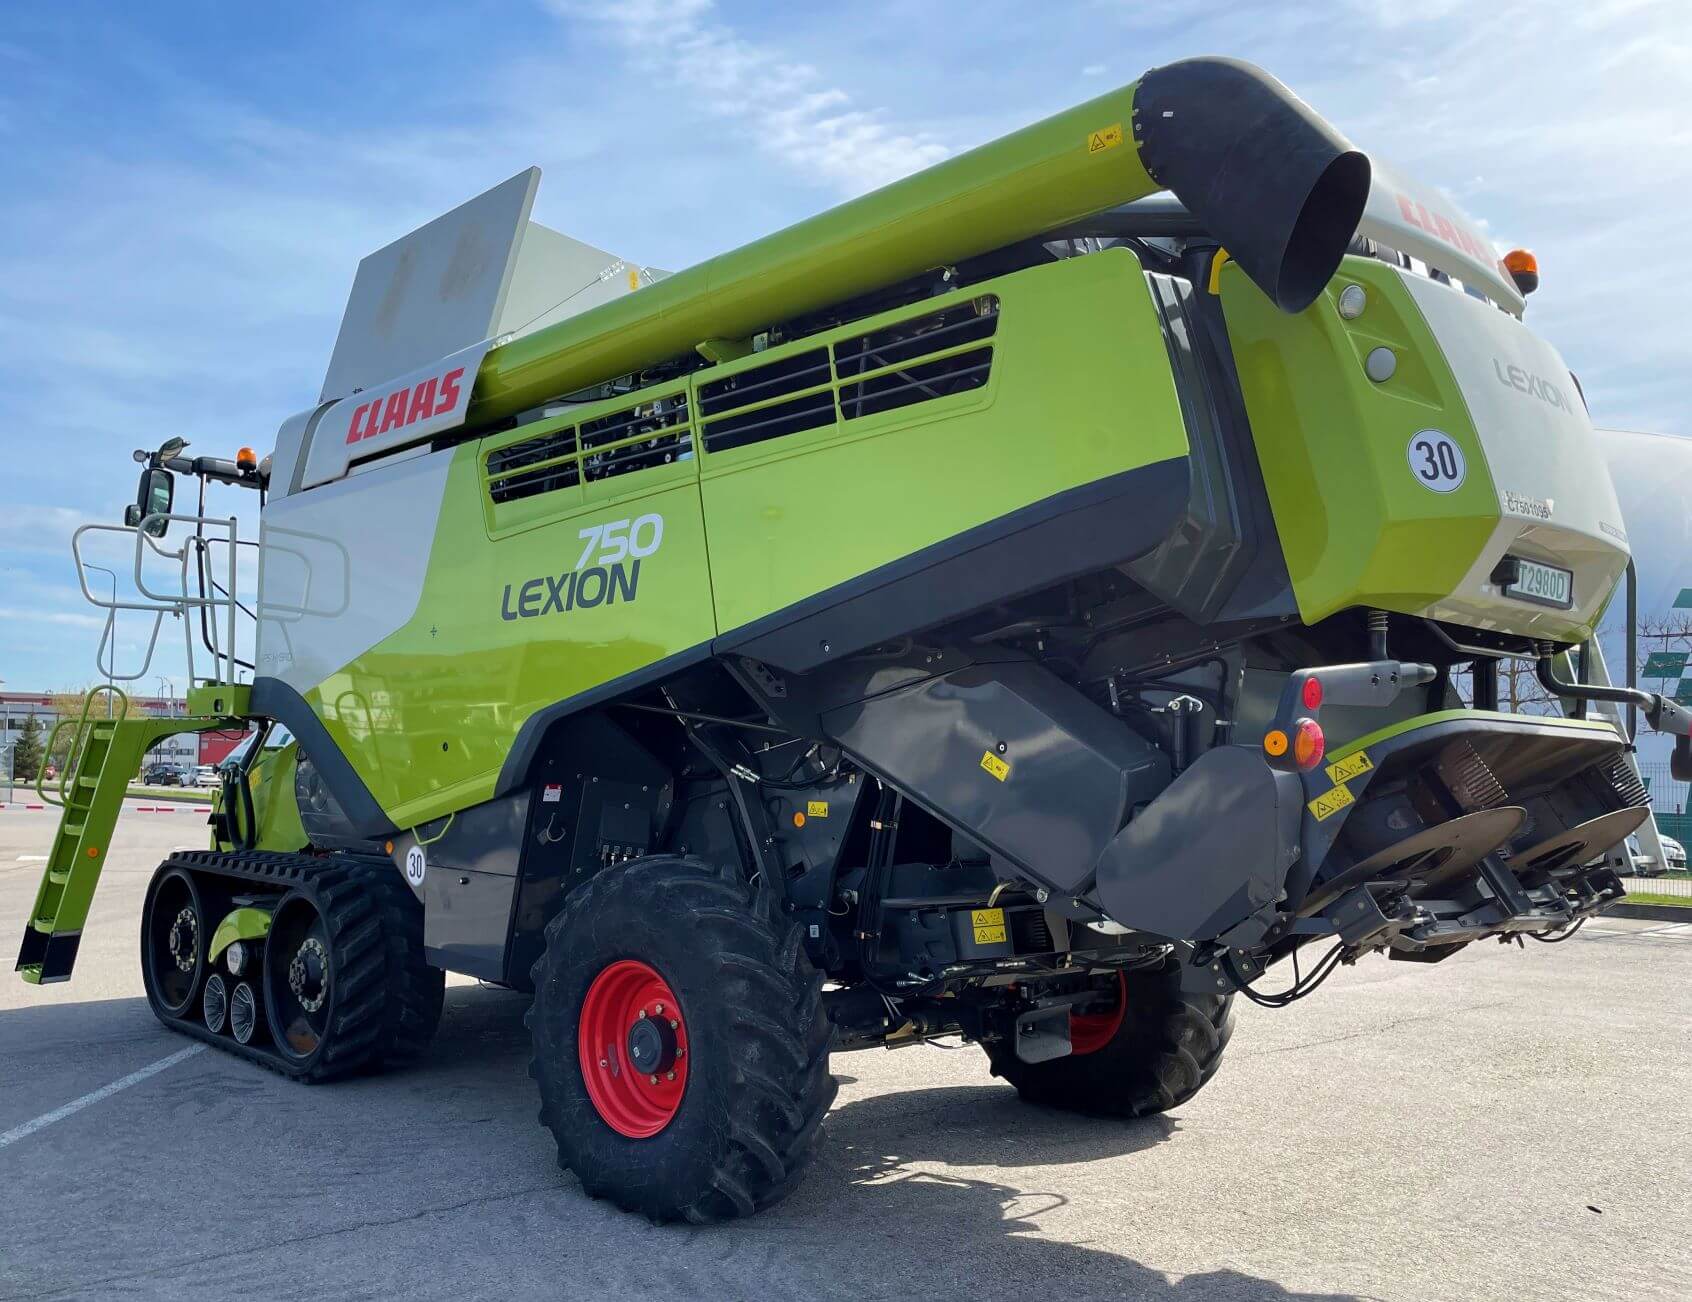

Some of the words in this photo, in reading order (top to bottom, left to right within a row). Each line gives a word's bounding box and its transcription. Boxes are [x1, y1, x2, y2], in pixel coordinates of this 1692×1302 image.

[346, 367, 465, 445] CLAAS
[1493, 358, 1574, 415] LEXION
[1416, 441, 1457, 480] 30
[575, 513, 664, 570] 750
[501, 559, 641, 621] LEXION
[409, 853, 422, 879] 30
